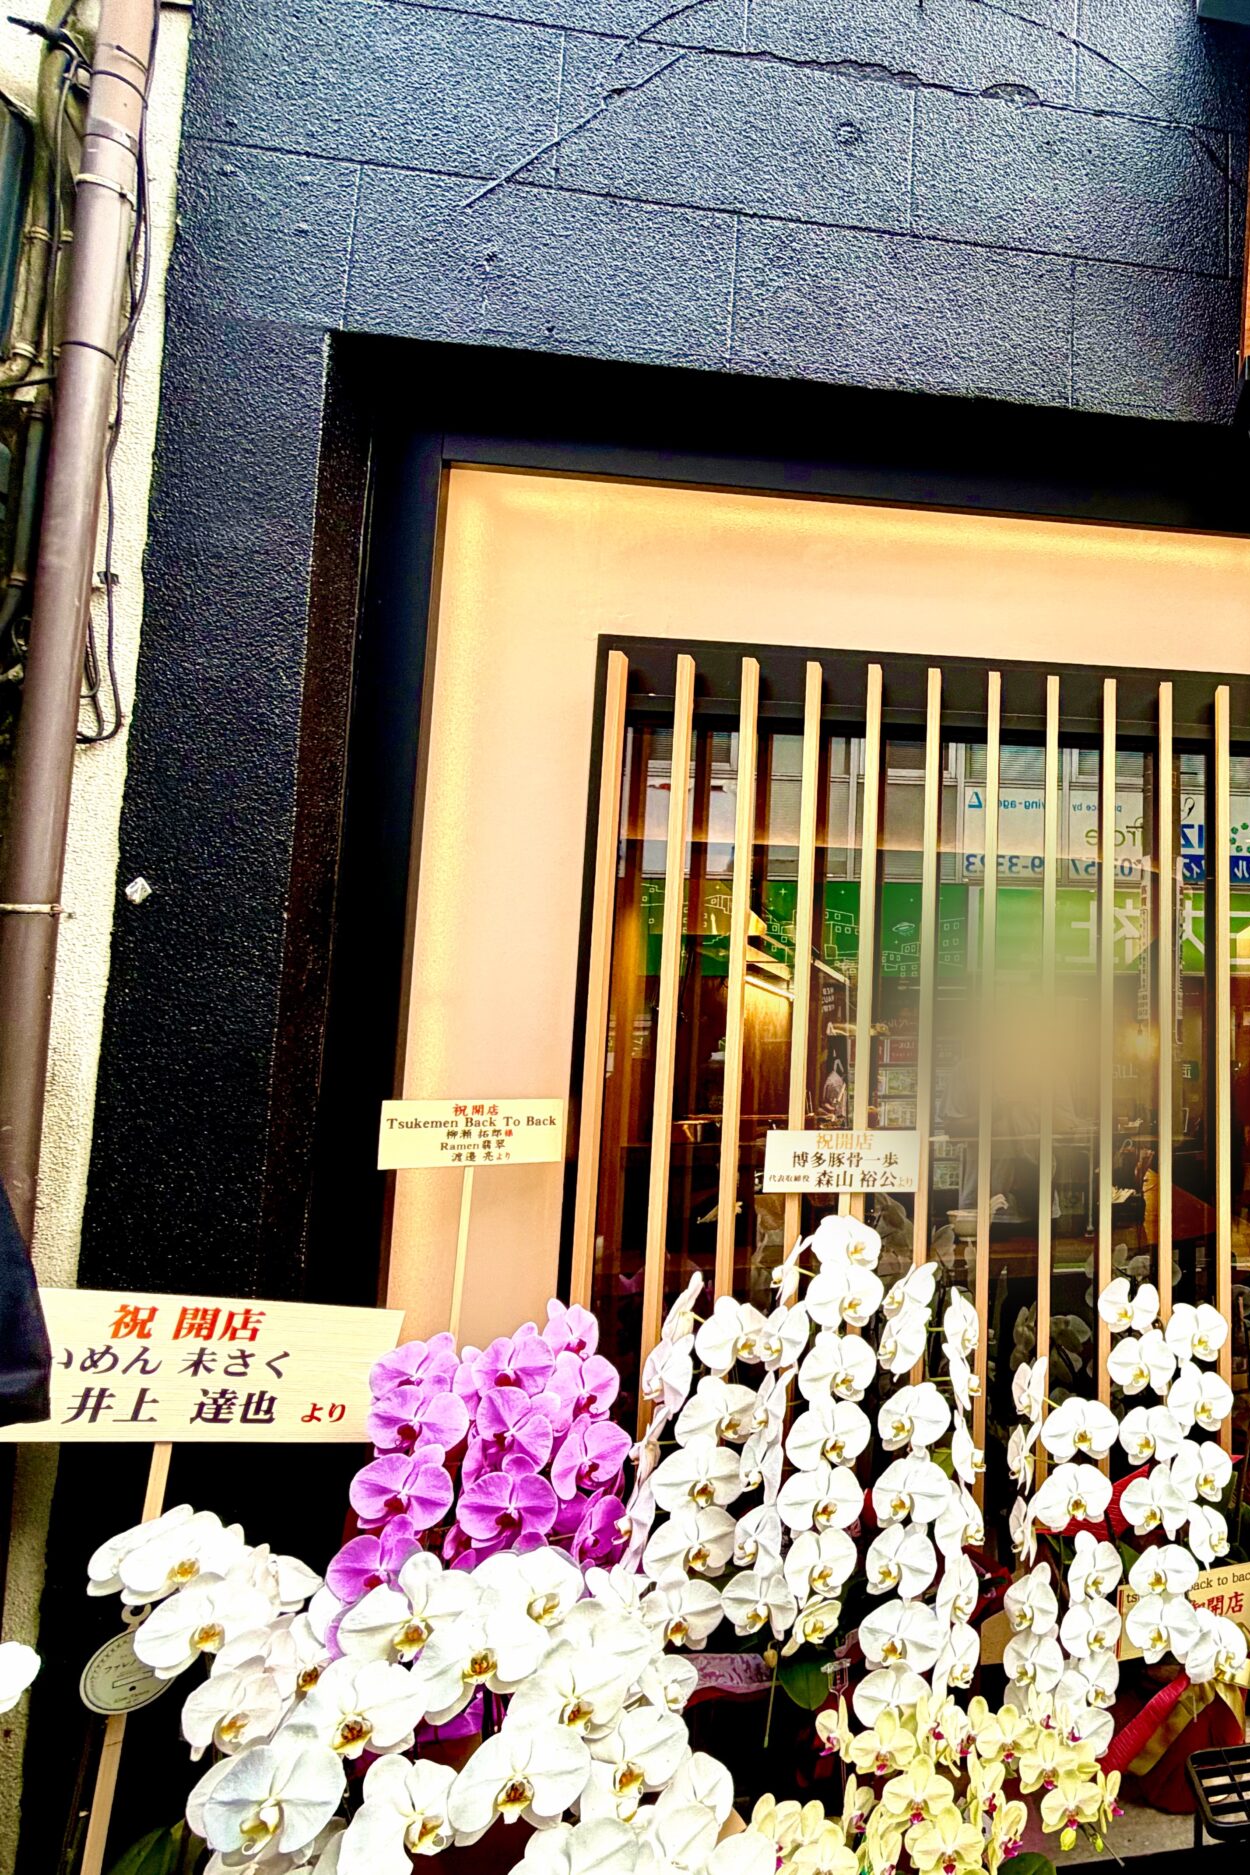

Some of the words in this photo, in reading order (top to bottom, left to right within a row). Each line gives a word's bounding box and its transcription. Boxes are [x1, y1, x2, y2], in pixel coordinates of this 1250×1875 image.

[454, 1104, 499, 1117] 祝開店
[387, 1117, 459, 1130] Tsukemen
[465, 1117, 497, 1128] Back
[503, 1117, 521, 1127] To
[526, 1116, 557, 1126] Back
[440, 1142, 480, 1151] Ramen
[816, 1133, 873, 1150] 祝開店
[793, 1151, 899, 1168] 博多豚骨一歩
[815, 1170, 853, 1188] 森山
[110, 1303, 159, 1340] 祝
[172, 1306, 266, 1342] 開店
[61, 1386, 160, 1424] 井上
[189, 1388, 280, 1425] 達也
[300, 1402, 347, 1424] より
[1217, 1577, 1228, 1586] to
